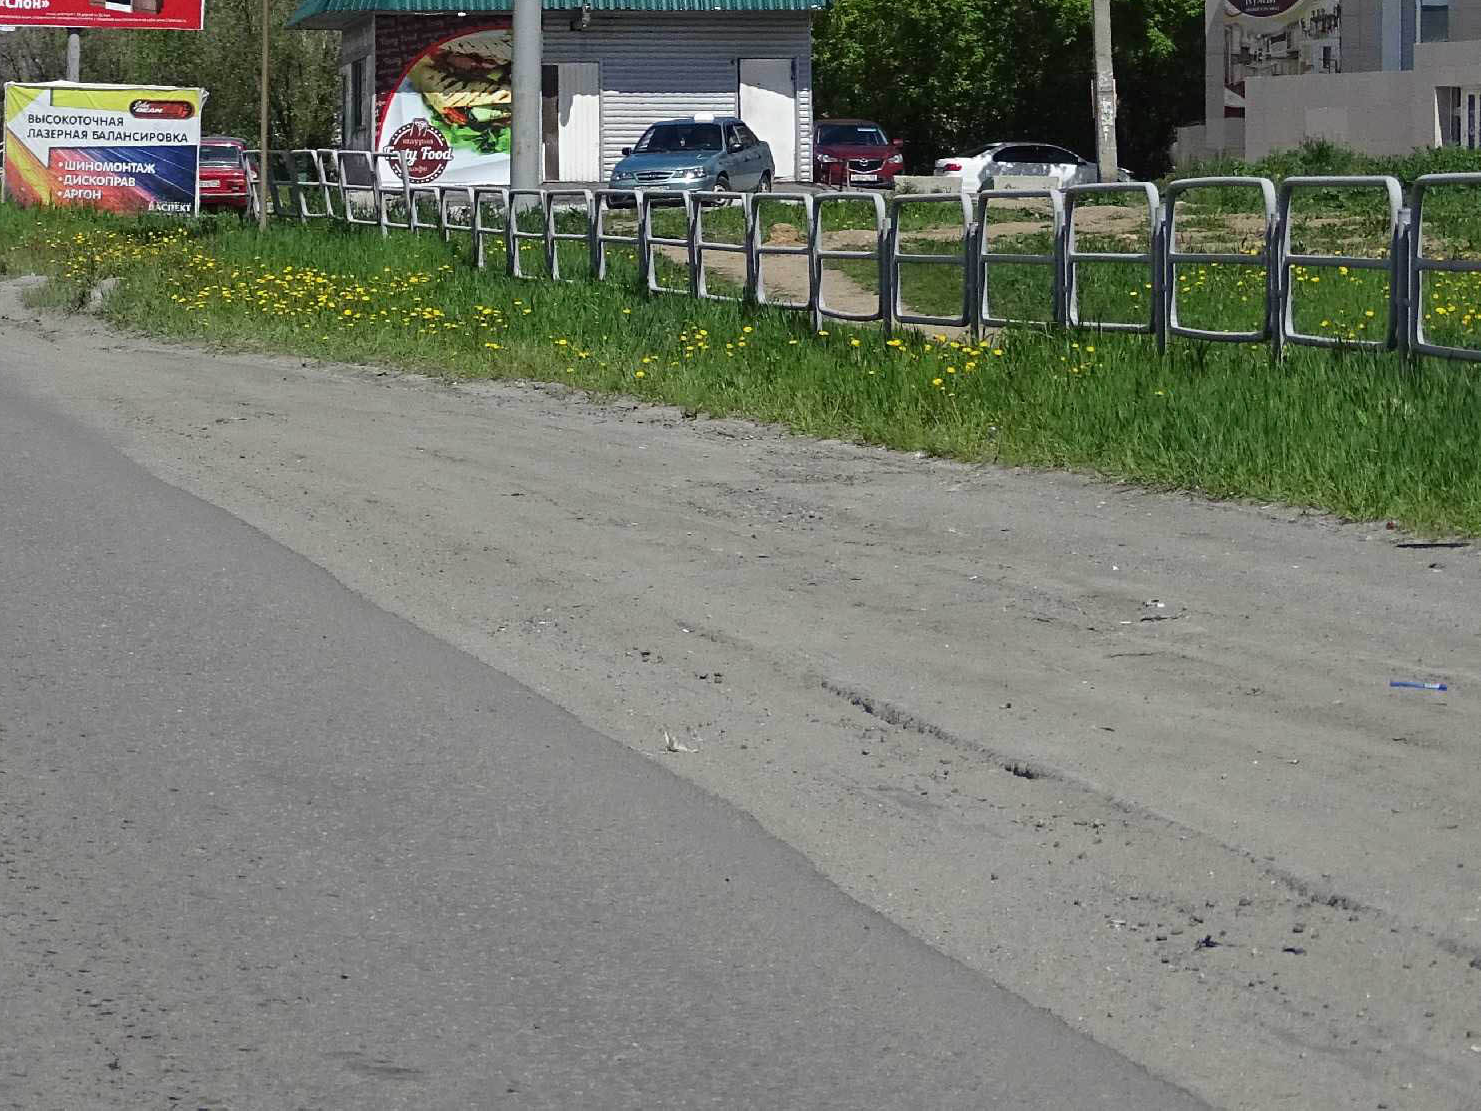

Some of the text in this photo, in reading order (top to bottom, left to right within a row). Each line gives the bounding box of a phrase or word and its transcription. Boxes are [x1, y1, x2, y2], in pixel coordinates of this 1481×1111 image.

[27, 114, 124, 127] ВЫСОКОТОЧНАЯ
[26, 128, 189, 143] ЛАЗЕРНАЯ БАЛАНСИРОВКА
[421, 146, 453, 160] Food
[64, 161, 156, 174] ШИНОМОНТАЖ
[62, 175, 136, 187] ДИСКОПРАВ
[62, 189, 102, 200] АРГОН
